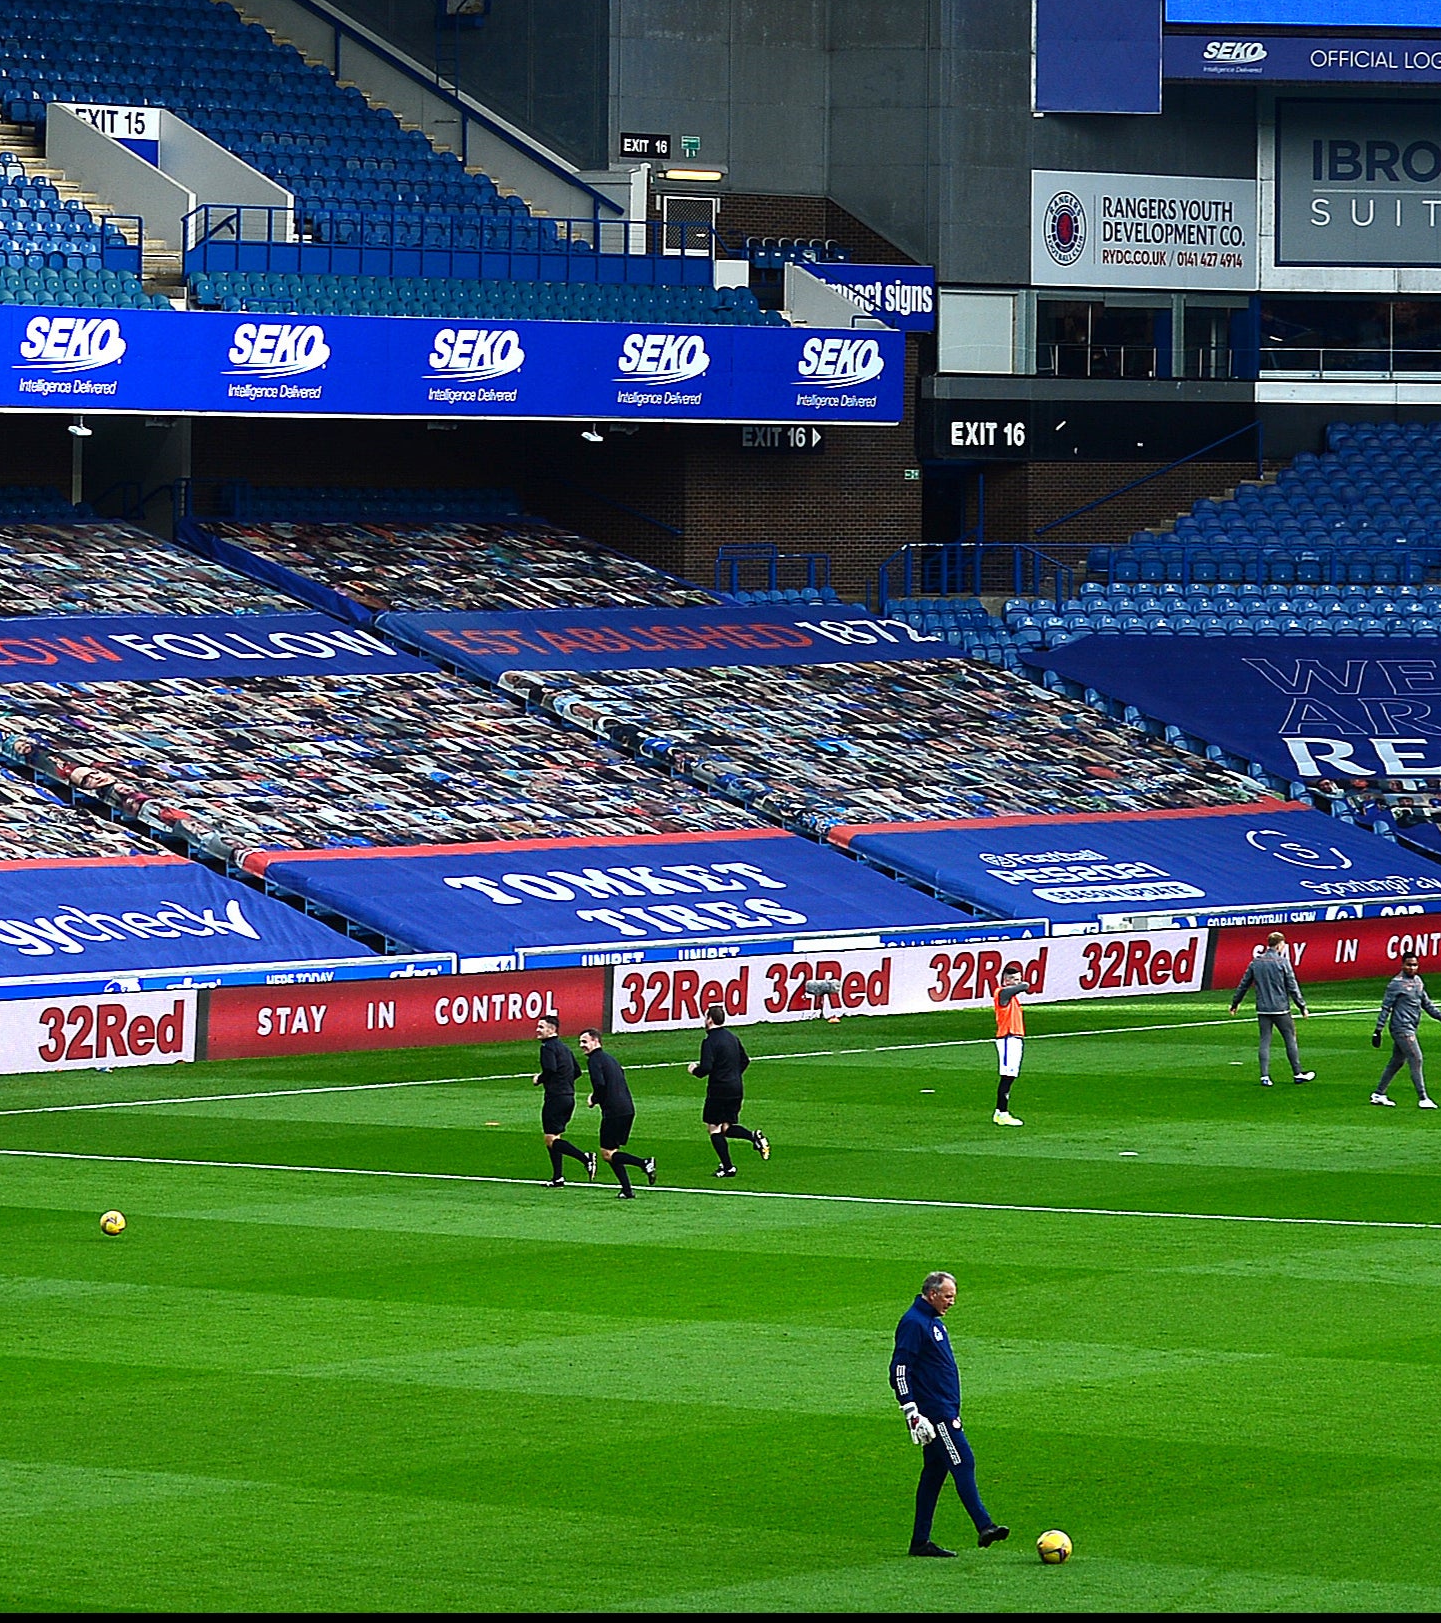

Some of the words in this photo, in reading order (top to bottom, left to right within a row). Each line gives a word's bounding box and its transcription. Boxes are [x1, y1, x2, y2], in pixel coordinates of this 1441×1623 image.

[1203, 41, 1267, 63] SEKO
[1310, 49, 1399, 71] OFFICIAL
[124, 112, 146, 135] 15
[623, 139, 649, 153] EXIT
[655, 140, 667, 153] 16
[1102, 196, 1177, 220] RANGERS
[1179, 199, 1233, 222] YOUTH
[1102, 221, 1217, 245] DEVELOPMENT
[1219, 225, 1245, 247] CO.
[1102, 248, 1167, 267] RYDC.CO.UK
[1177, 250, 1198, 267] 0141
[1200, 251, 1218, 268] 427
[1219, 252, 1243, 269] 4914
[885, 280, 933, 316] signs
[19, 317, 126, 362] SEKO
[228, 324, 331, 368] SEKO
[429, 329, 525, 371] SEKO
[618, 334, 710, 374] SEKO
[798, 337, 884, 376] SEKO
[19, 380, 70, 396] Intelligence
[73, 380, 117, 396] Delivered
[228, 383, 277, 400] Intelligence
[279, 384, 321, 401] Delivered
[428, 388, 476, 403] Intelligence
[478, 389, 518, 404] Delivered
[617, 391, 661, 406] Intelligence
[664, 392, 702, 406] Delivered
[796, 393, 838, 408] Intelligence
[840, 394, 877, 409] Delivered
[742, 427, 782, 448] EXIT
[787, 427, 806, 448] 16
[951, 422, 998, 446] EXIT
[1004, 422, 1025, 446] 16
[108, 629, 399, 660] FOLLOW
[424, 623, 814, 656] ESTABLISHED
[794, 619, 943, 645] 1872
[444, 862, 787, 905] TOMKET
[576, 898, 808, 937] TIRES
[1079, 937, 1198, 990] 32Red
[1253, 942, 1306, 967] SAY
[1335, 938, 1358, 964] IN
[621, 966, 748, 1024] 32Red
[258, 1005, 326, 1036] STAY
[367, 1001, 395, 1030] IN
[434, 990, 558, 1026] CONTROL
[38, 1000, 184, 1063] 32Red
